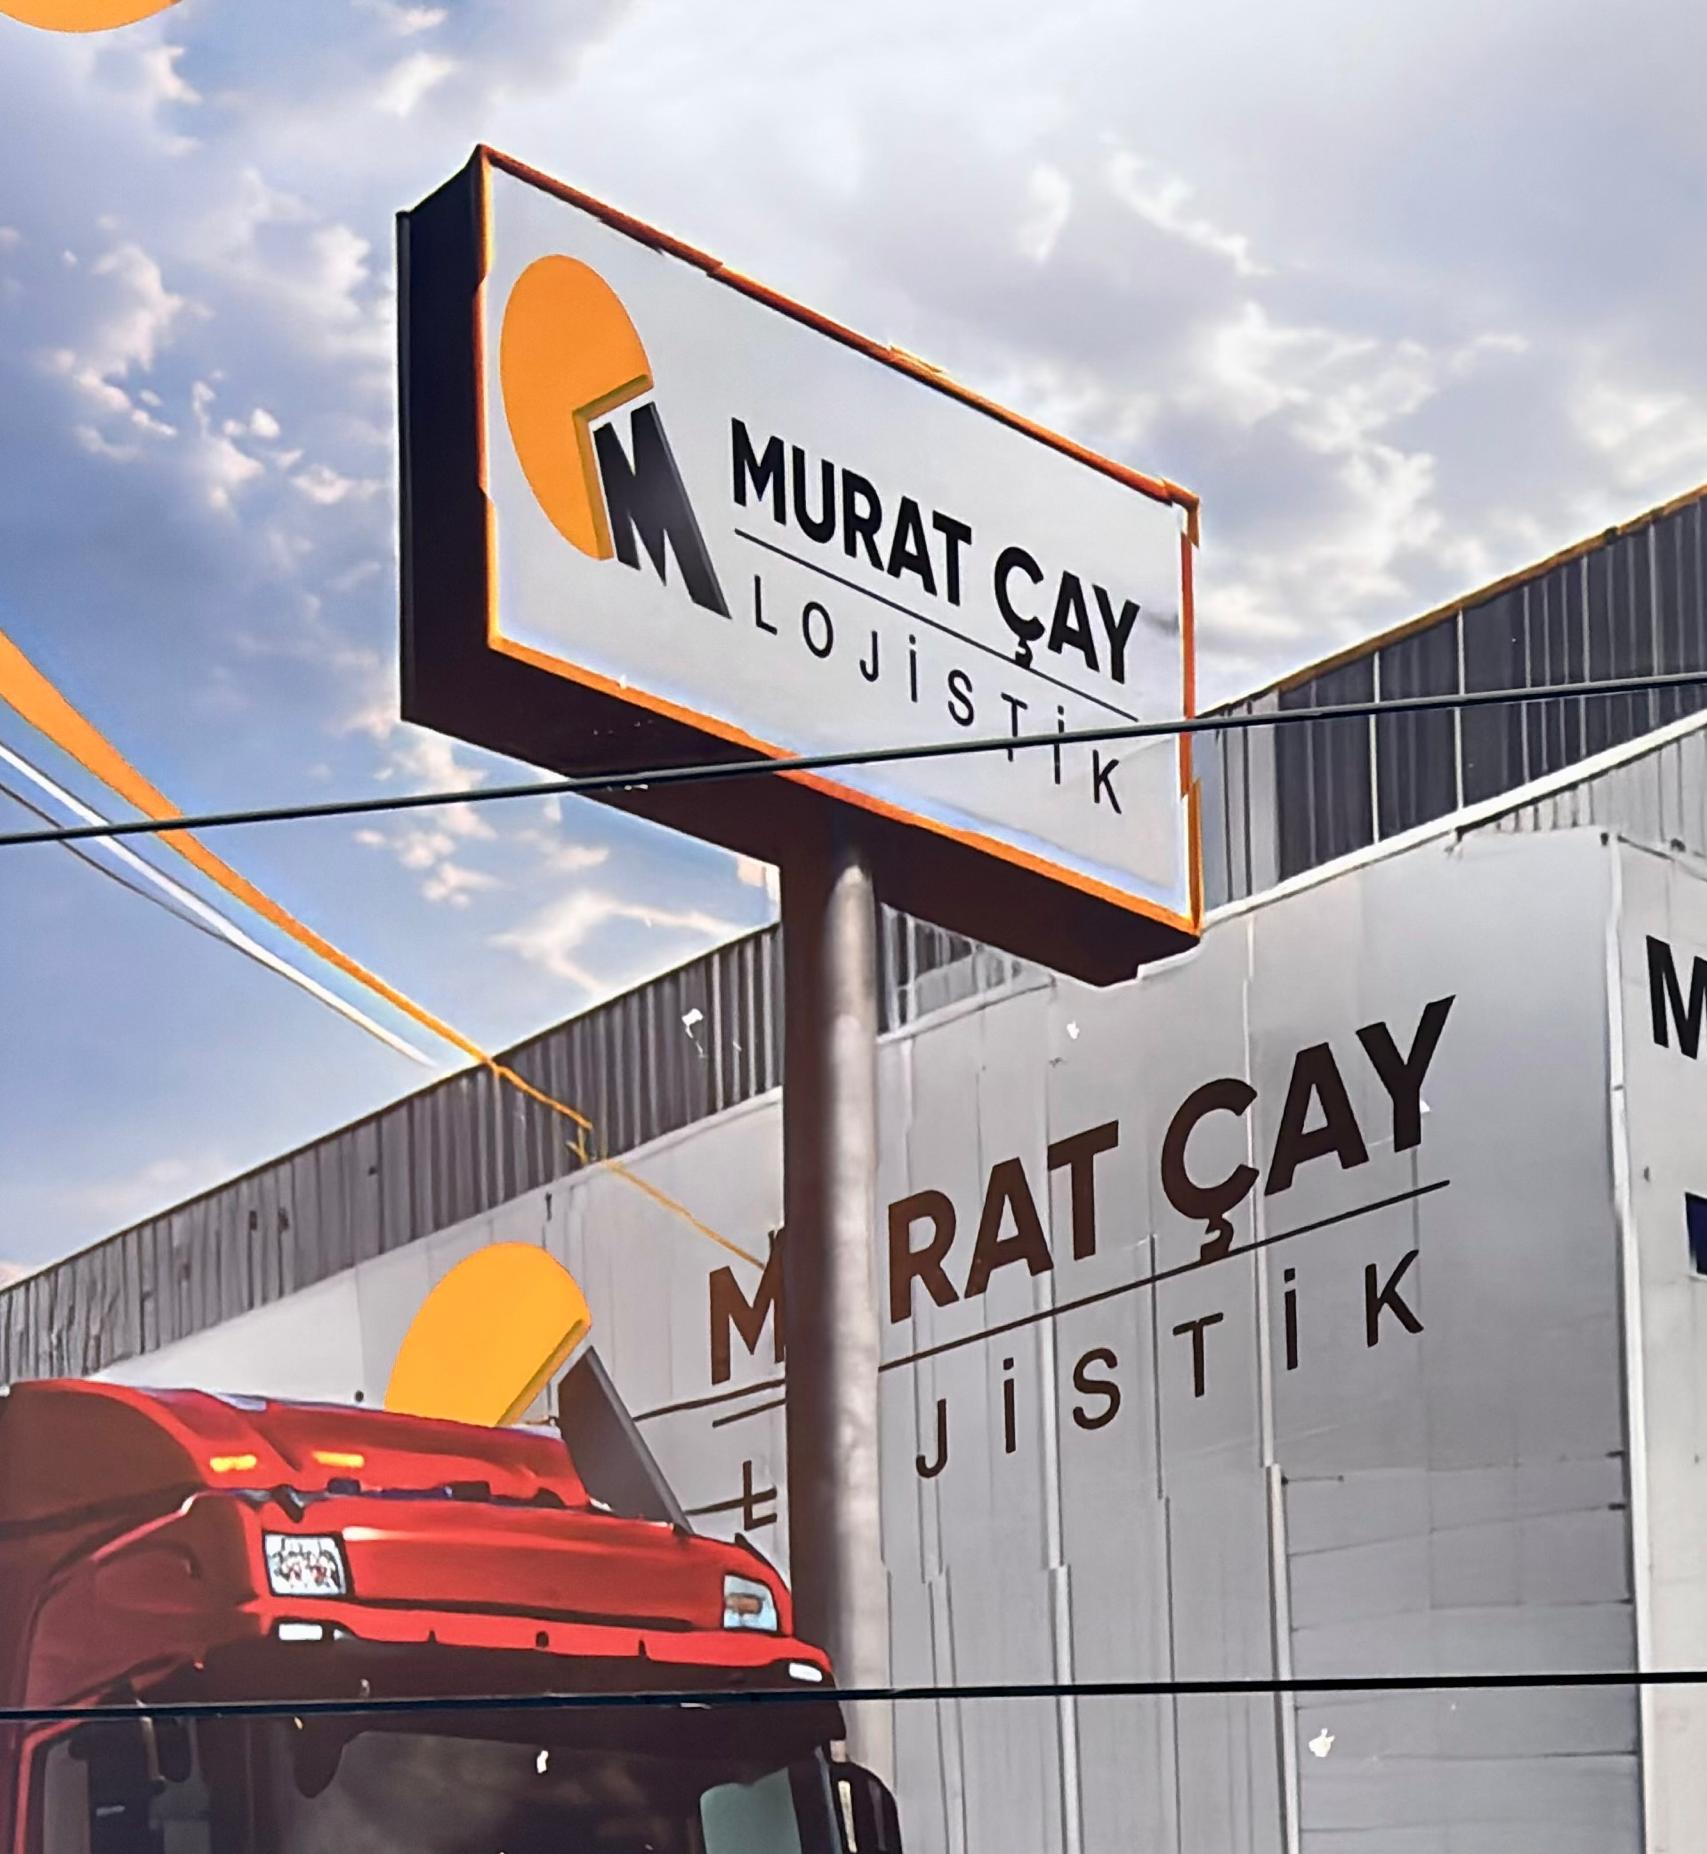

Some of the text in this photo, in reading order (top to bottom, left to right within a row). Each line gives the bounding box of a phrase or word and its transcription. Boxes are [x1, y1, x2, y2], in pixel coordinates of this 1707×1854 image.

[730, 418, 1140, 685] MURAT ÇAY
[755, 576, 1122, 814] LOJİSTİK
[710, 995, 1456, 1385] MRAT ÇAY
